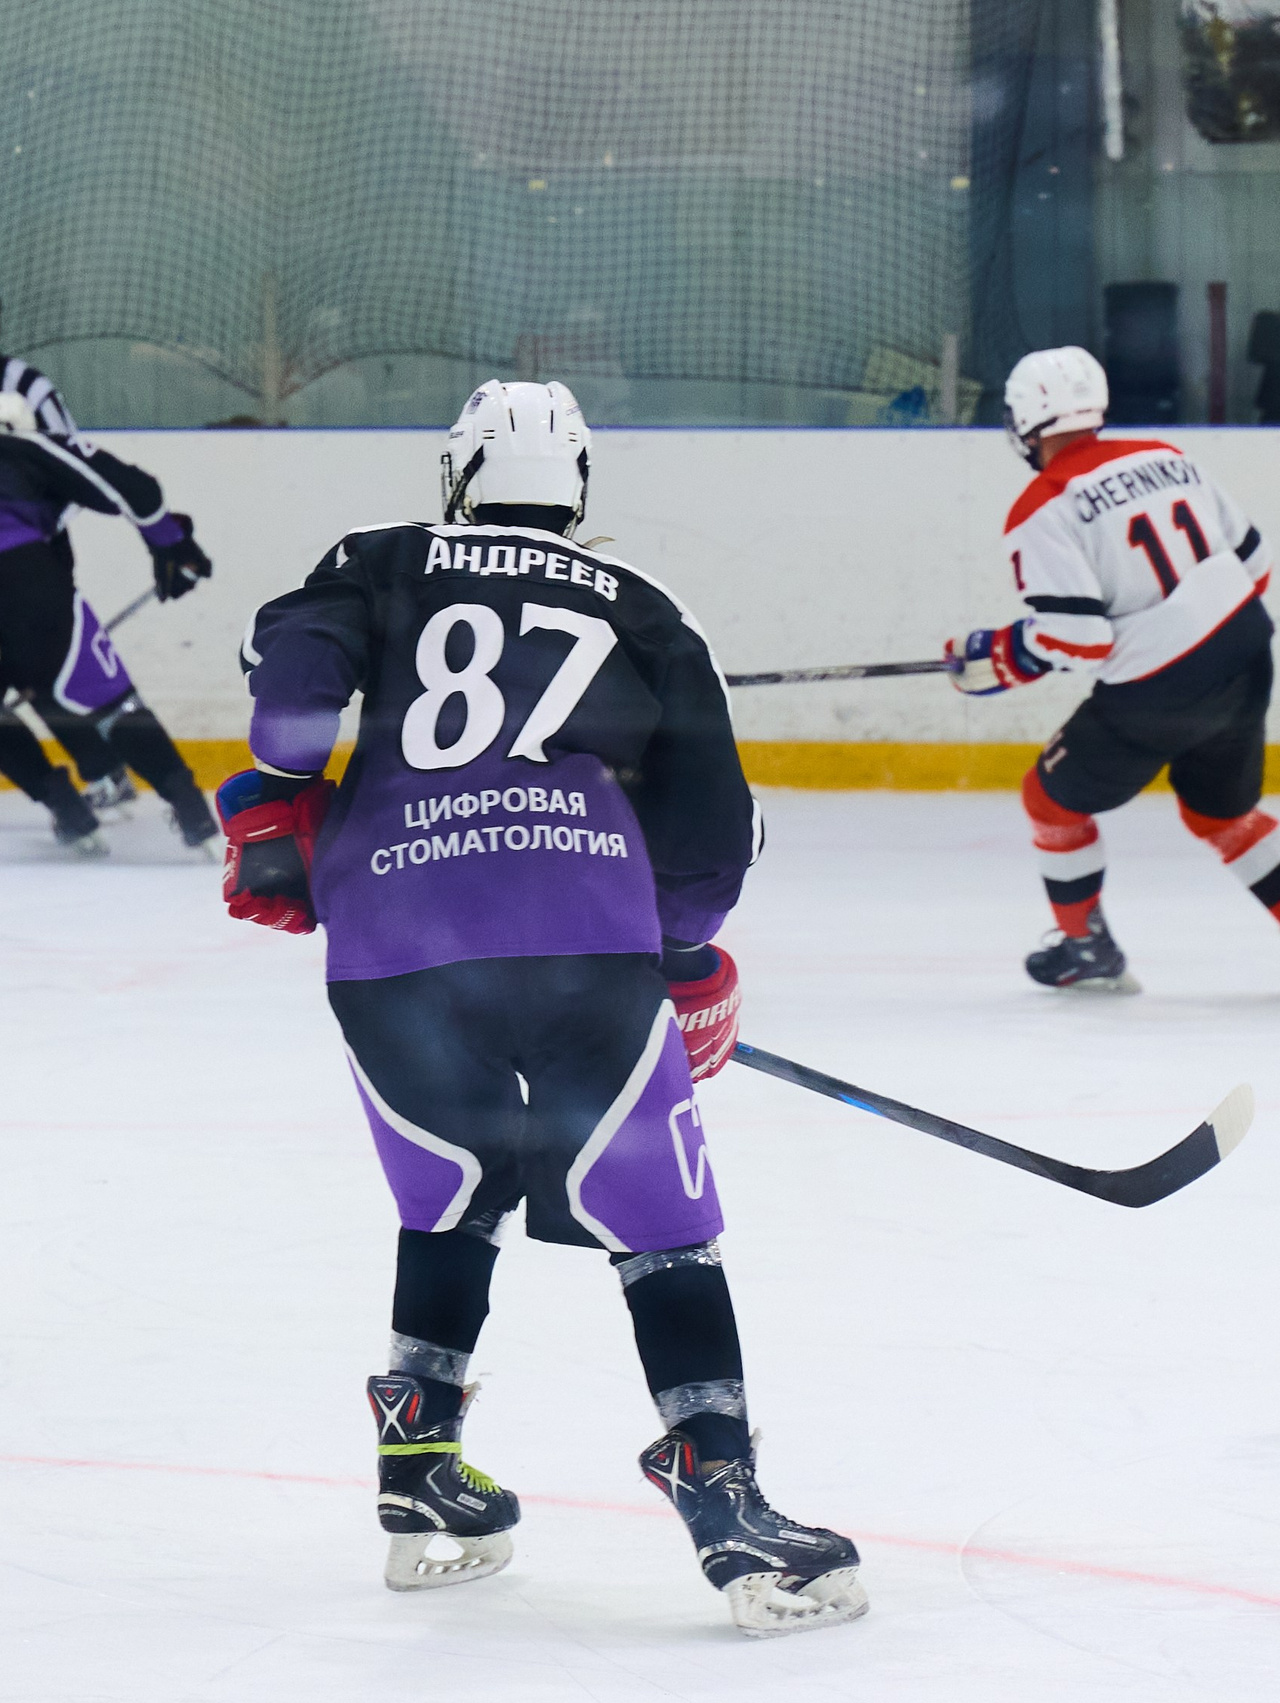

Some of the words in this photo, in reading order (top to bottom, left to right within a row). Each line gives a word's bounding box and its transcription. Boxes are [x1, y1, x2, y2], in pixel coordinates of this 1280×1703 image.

[424, 537, 620, 602] АНДРЕЕВ
[1127, 499, 1212, 599] 11
[401, 602, 619, 770] 87
[404, 787, 587, 830] ЦИФРОВАЯ
[370, 825, 628, 876] СТОМАТОЛОГИЯ
